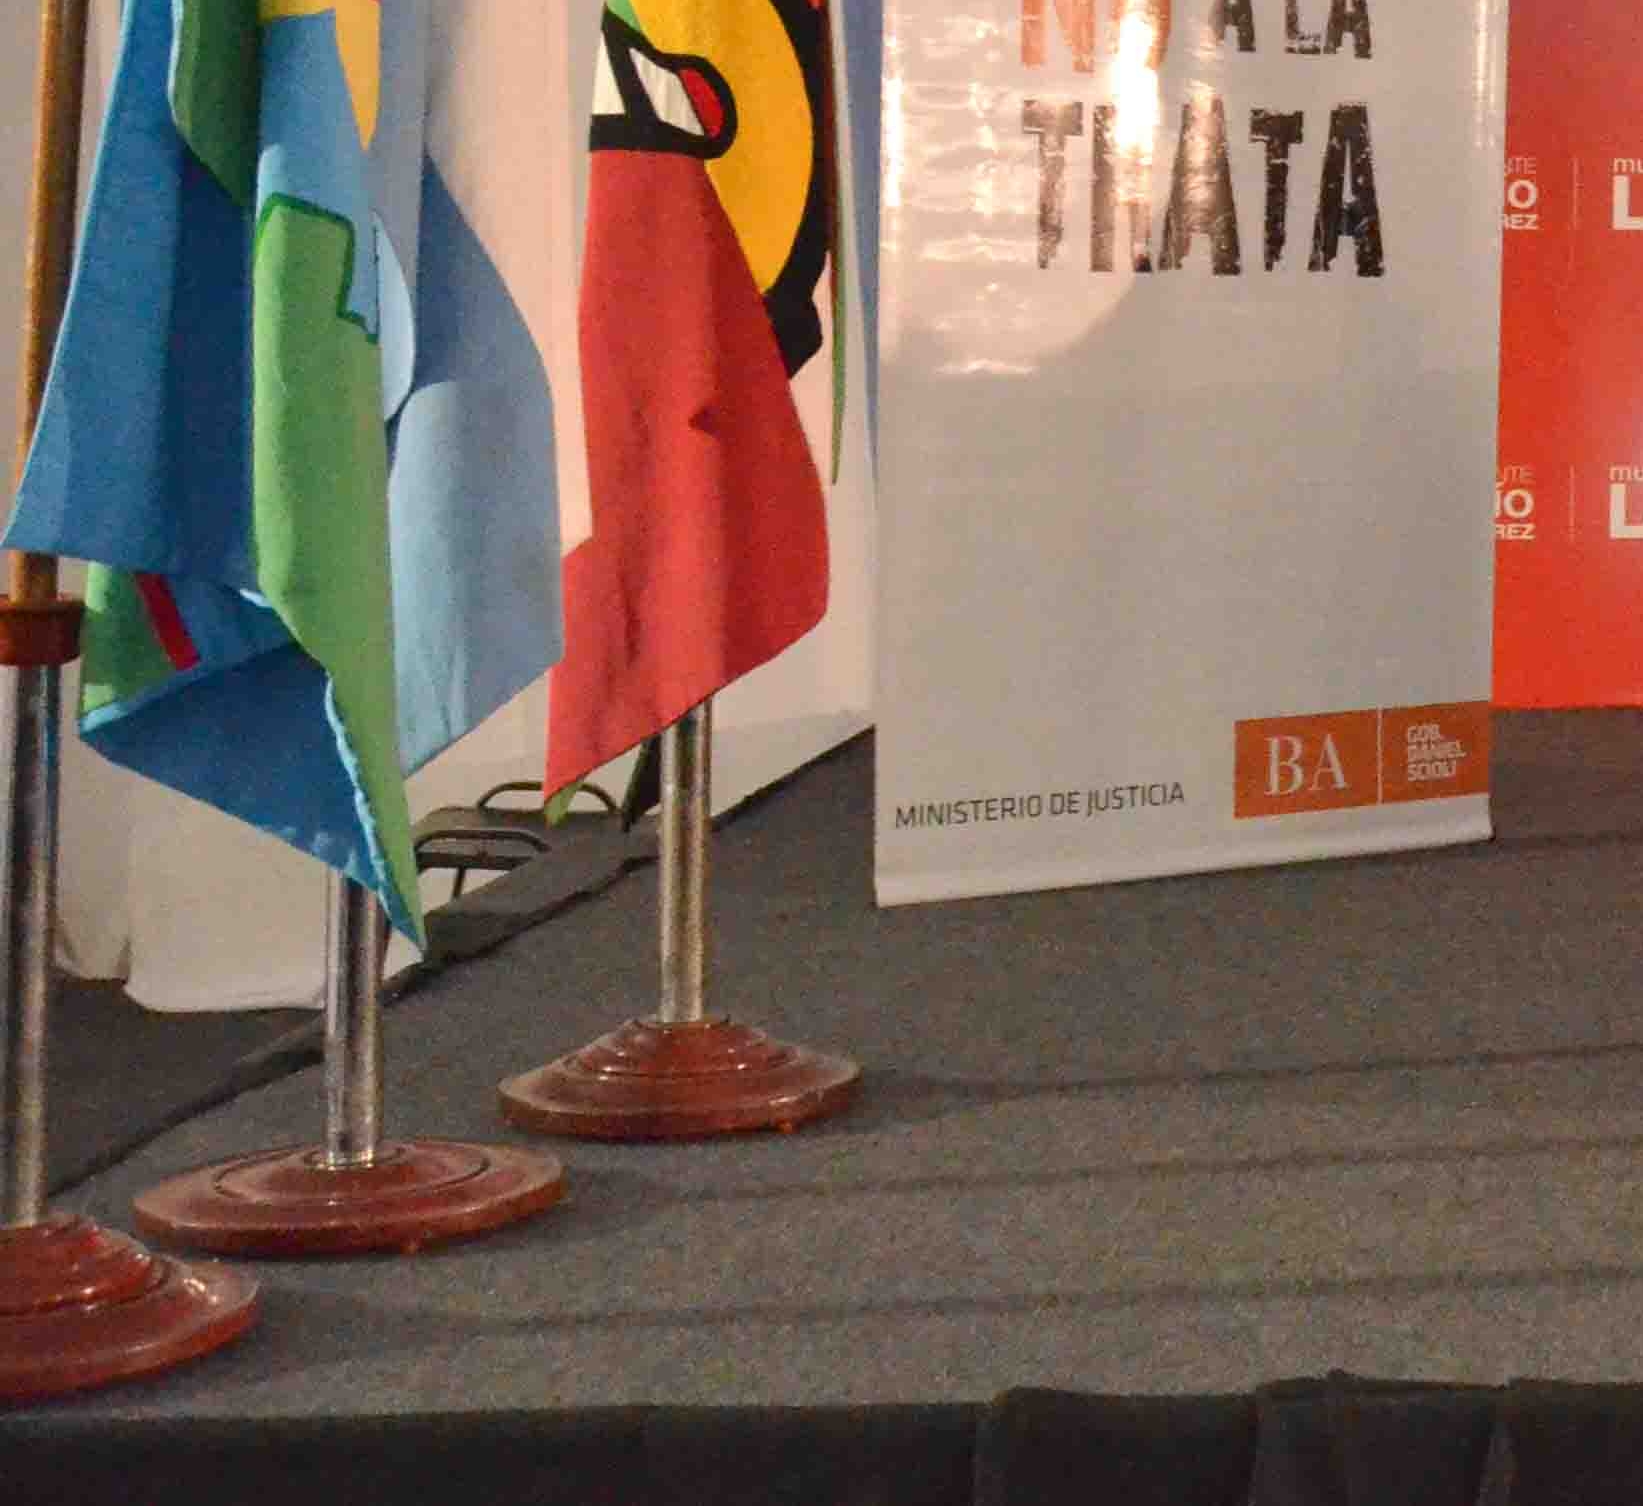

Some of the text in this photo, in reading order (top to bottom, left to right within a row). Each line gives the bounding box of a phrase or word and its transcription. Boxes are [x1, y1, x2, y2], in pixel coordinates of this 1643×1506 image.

[1264, 733, 1350, 796] BA
[895, 781, 1185, 829] MINISTERIO DE JUSTICIA
